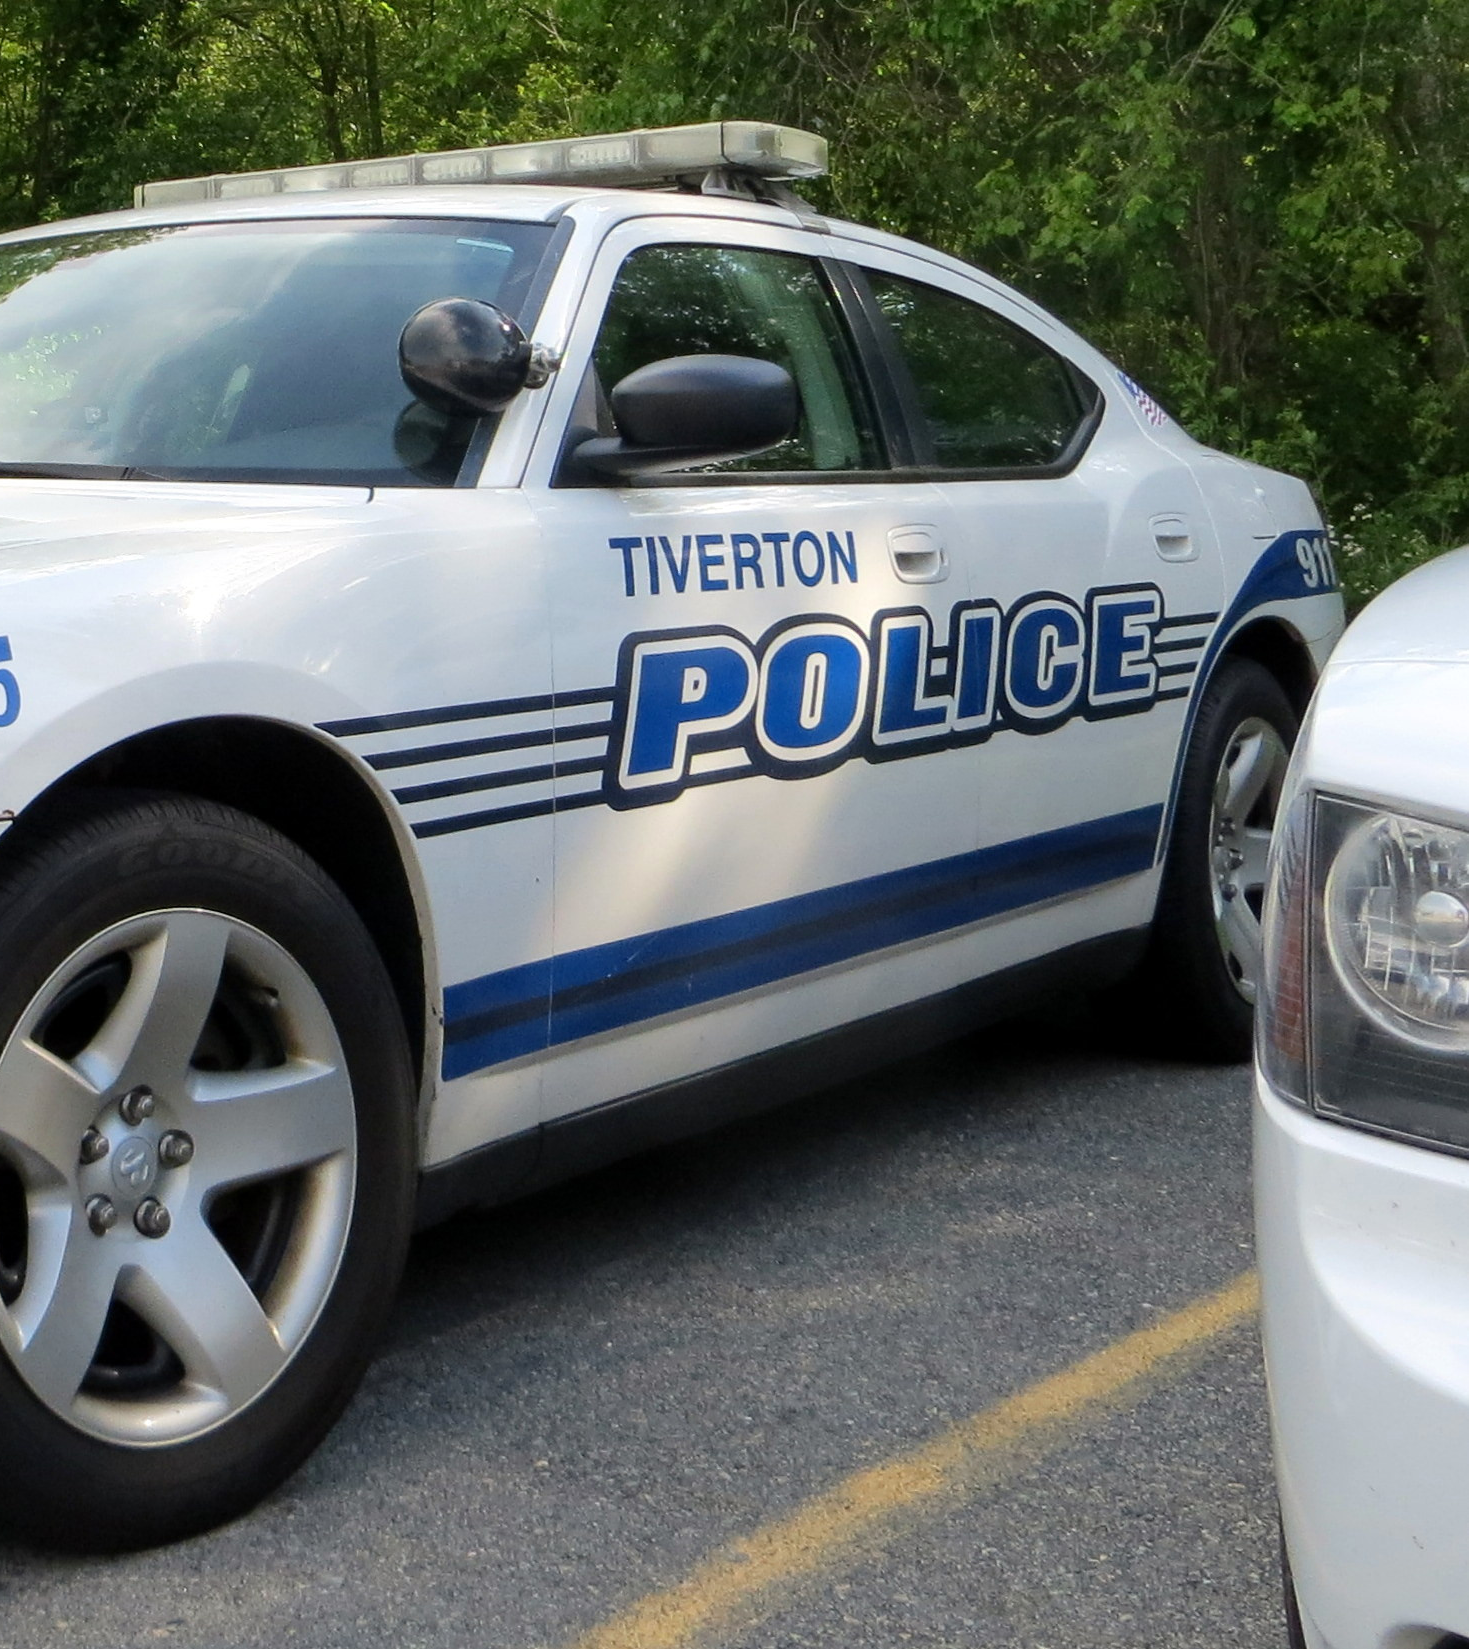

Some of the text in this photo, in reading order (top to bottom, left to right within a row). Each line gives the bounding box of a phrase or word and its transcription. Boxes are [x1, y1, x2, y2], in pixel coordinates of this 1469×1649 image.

[608, 530, 859, 597] TIVERTON
[1295, 538, 1338, 588] 911
[615, 586, 1162, 800] POLICE
